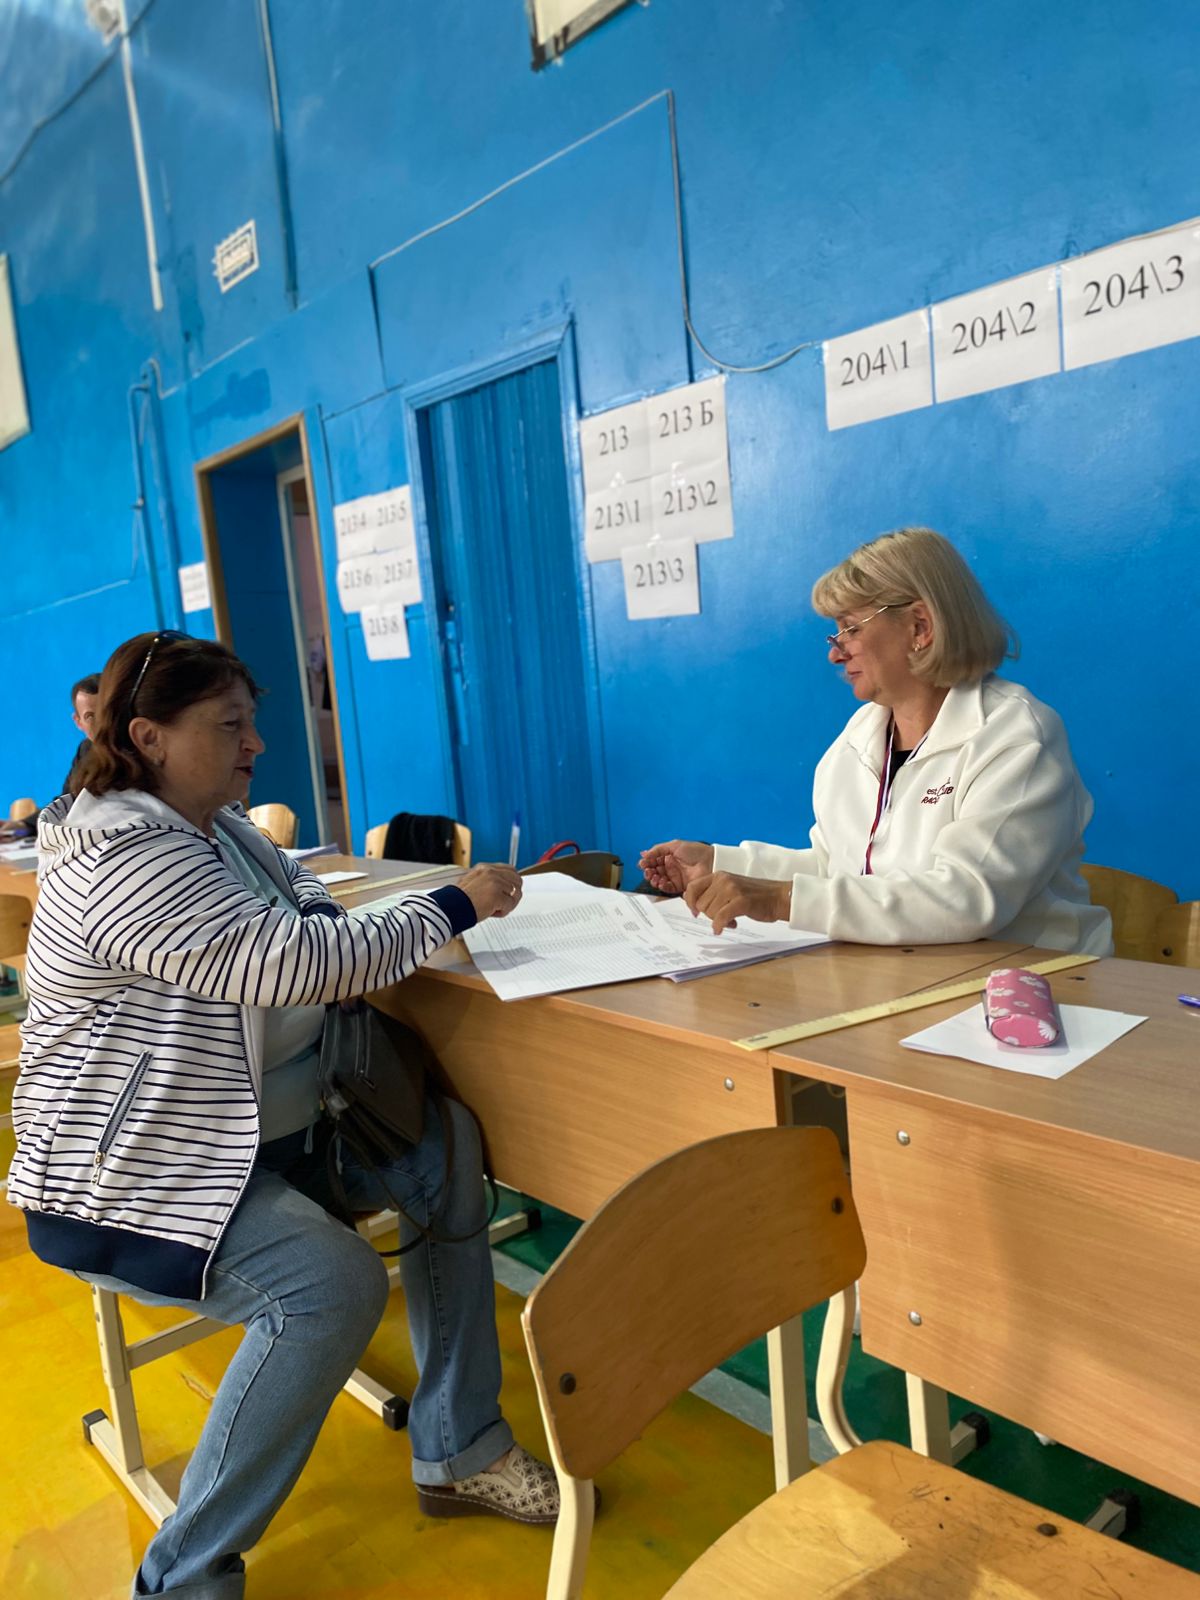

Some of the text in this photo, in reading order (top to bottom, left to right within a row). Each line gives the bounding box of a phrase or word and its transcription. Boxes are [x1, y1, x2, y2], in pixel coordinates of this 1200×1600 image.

[1083, 255, 1185, 316] 204\3
[952, 301, 1037, 354] 204\2
[841, 340, 910, 386] 204\1
[659, 399, 714, 438] 213 Б
[599, 425, 629, 456] 213
[594, 499, 641, 530] 213\1
[664, 480, 718, 516] 213\2
[634, 557, 685, 588] 213\3
